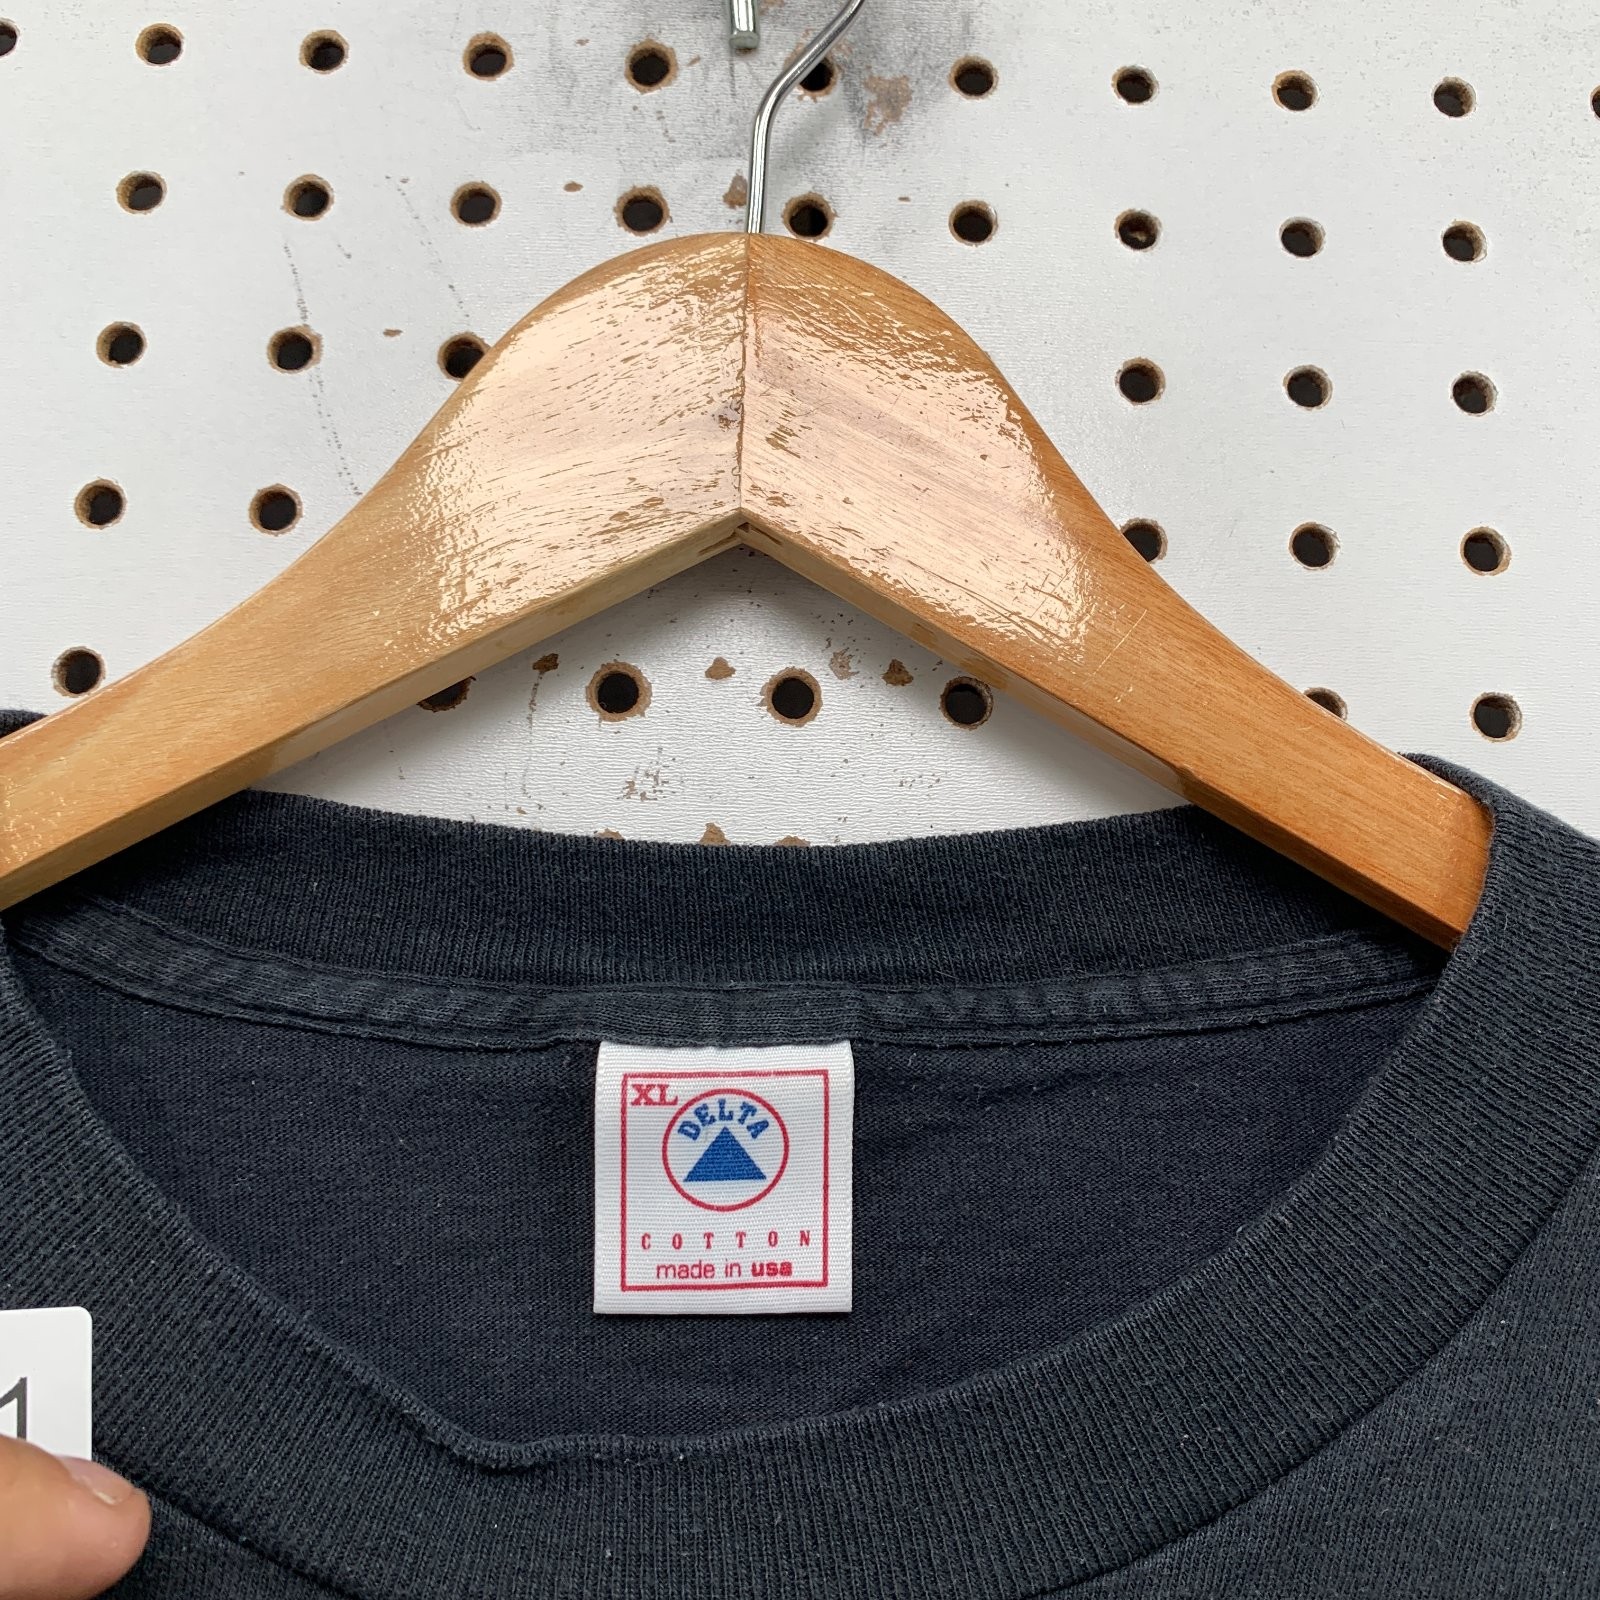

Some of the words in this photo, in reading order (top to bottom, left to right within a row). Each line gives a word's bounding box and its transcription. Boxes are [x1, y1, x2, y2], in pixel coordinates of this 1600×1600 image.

[630, 1083, 679, 1107] XL
[677, 1098, 770, 1141] DELTA
[640, 1230, 811, 1250] COTTON
[656, 1259, 716, 1280] made
[724, 1258, 742, 1277] in
[751, 1260, 793, 1278] usa
